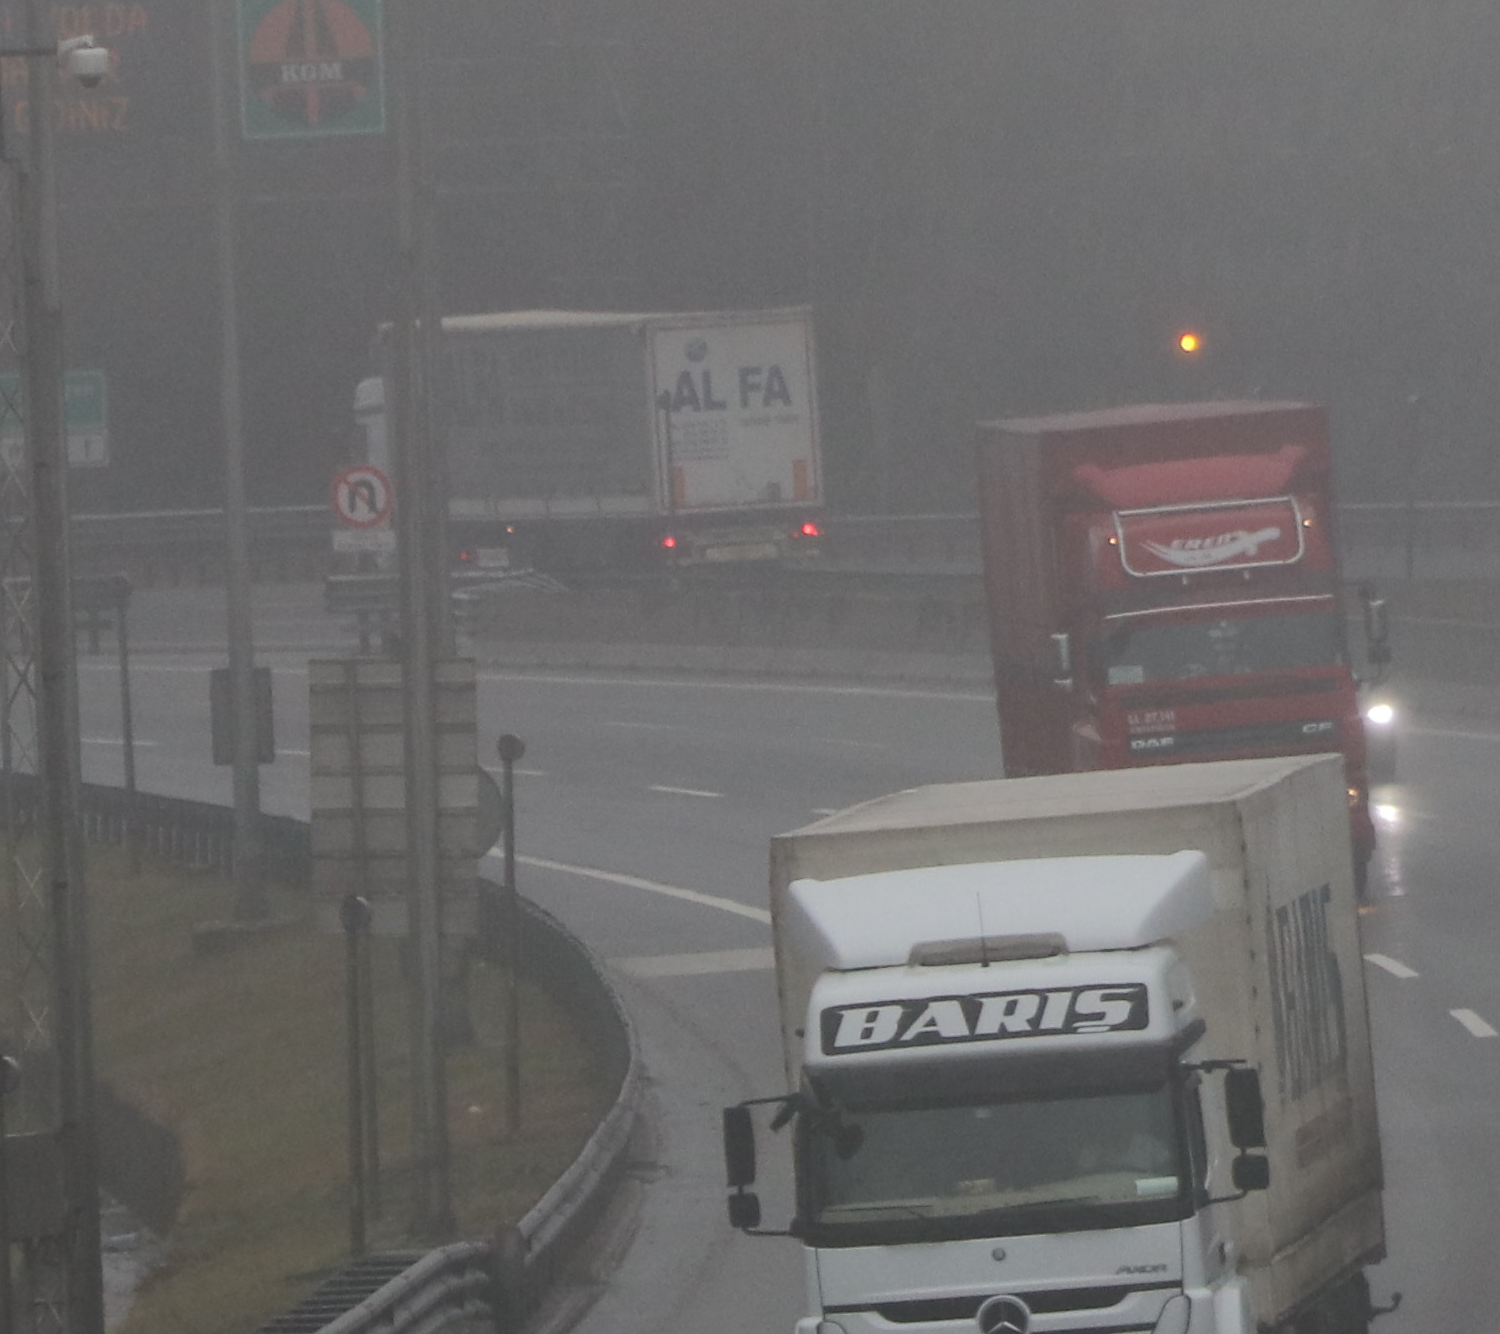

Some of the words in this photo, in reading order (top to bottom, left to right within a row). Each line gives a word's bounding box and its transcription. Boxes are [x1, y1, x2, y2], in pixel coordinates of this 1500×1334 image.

[1301, 721, 1334, 735] CF
[1131, 737, 1175, 750] DAF
[832, 987, 1138, 1052] BARIŞ
